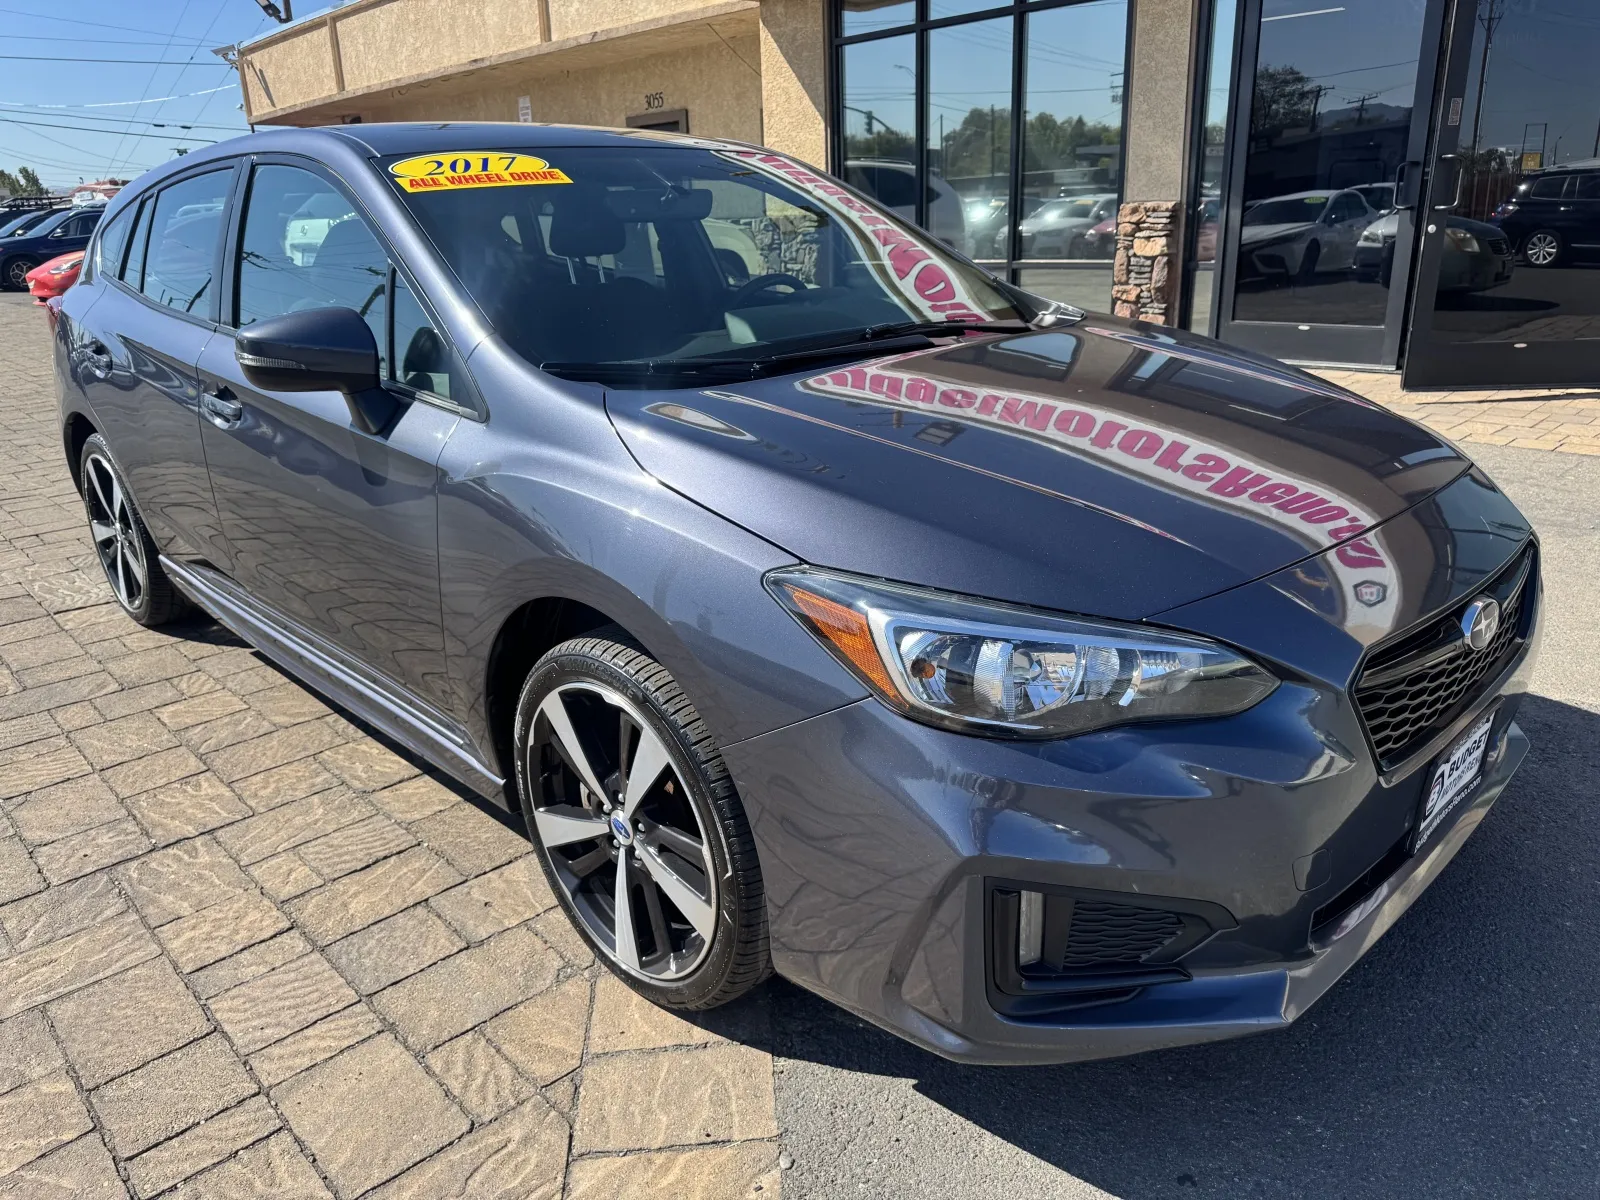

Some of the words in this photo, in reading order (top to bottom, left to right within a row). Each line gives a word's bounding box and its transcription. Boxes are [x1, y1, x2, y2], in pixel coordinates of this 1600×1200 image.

[645, 92, 664, 111] 3055
[424, 156, 518, 176] 2017
[409, 177, 444, 190] ALL
[445, 171, 509, 186] WHEEL
[509, 169, 560, 183] DRIVE
[1447, 728, 1491, 780] BUDGET
